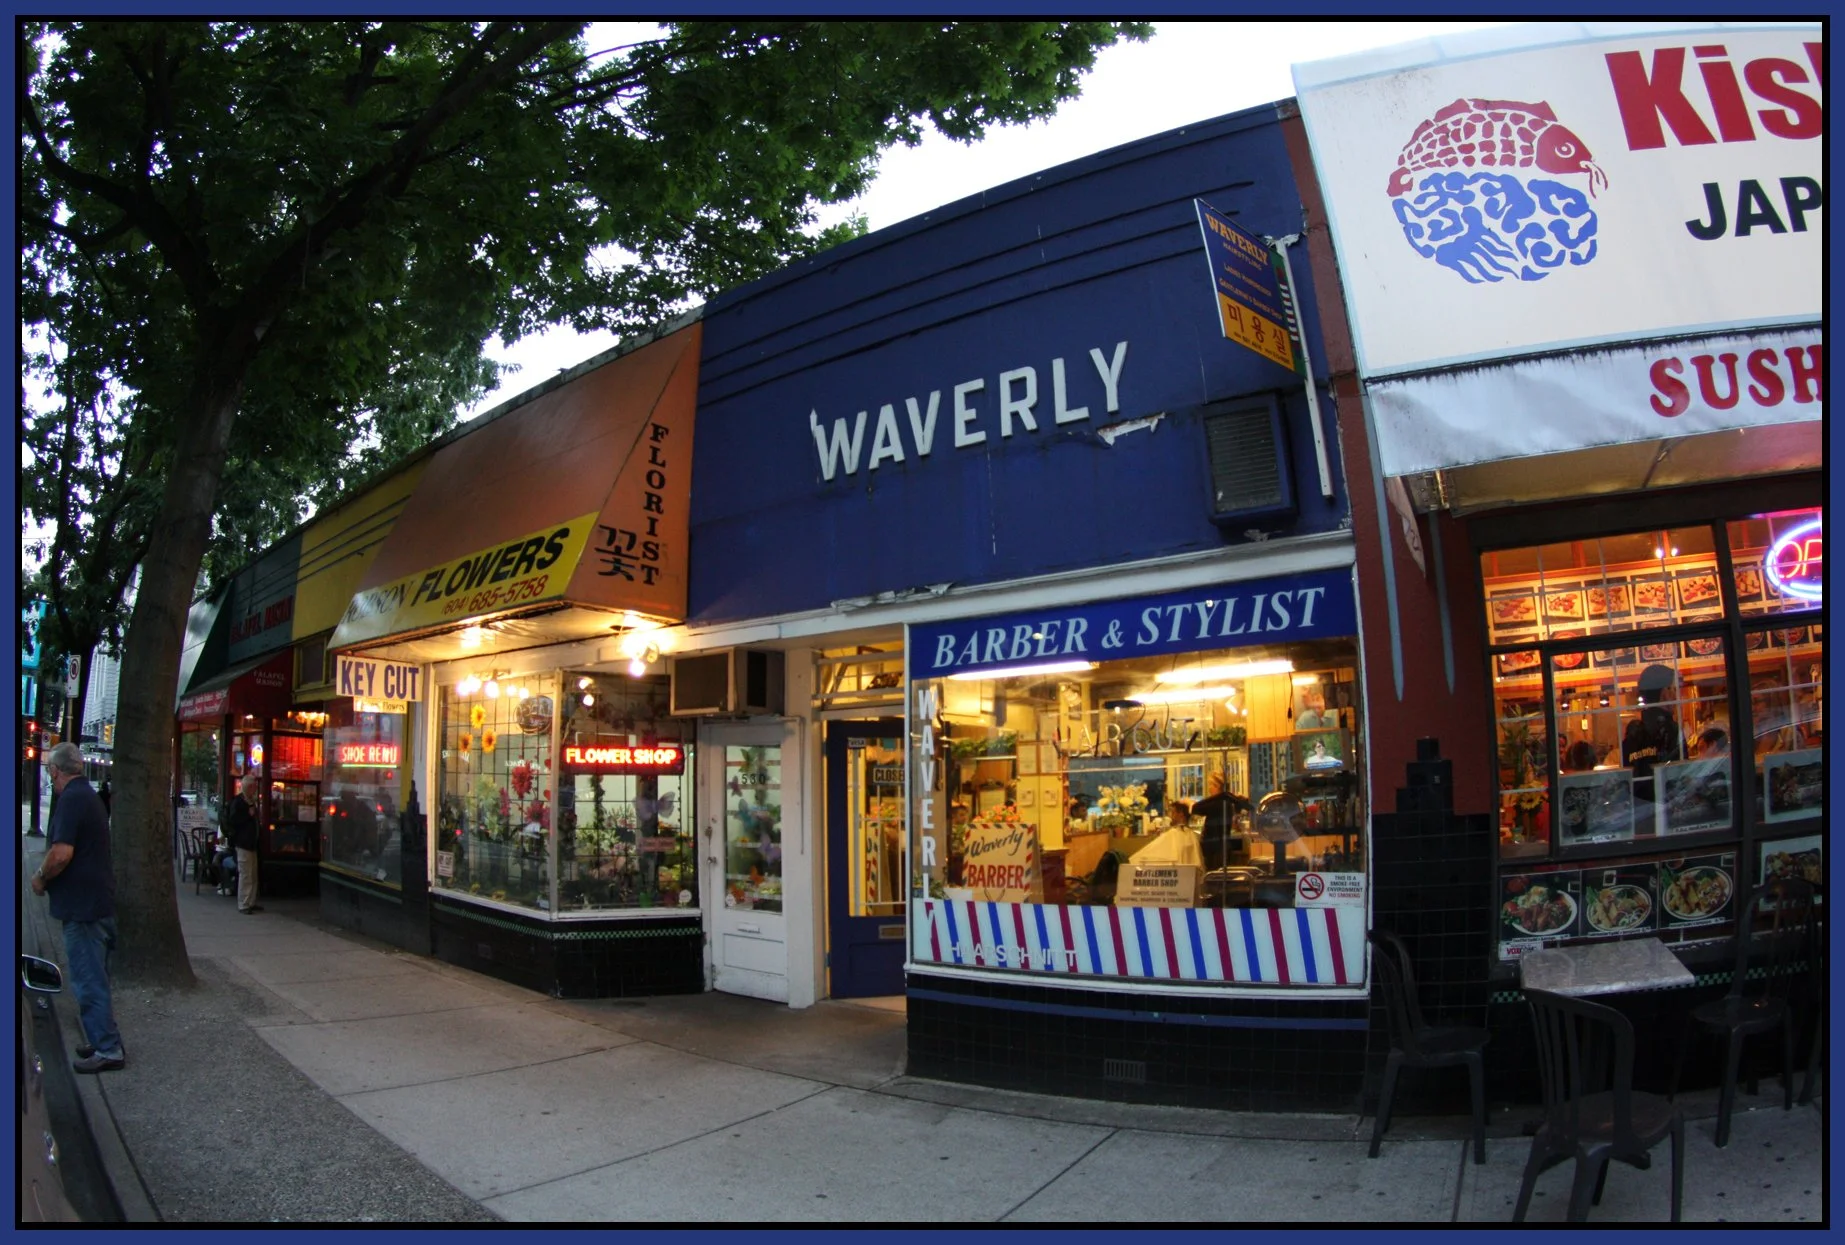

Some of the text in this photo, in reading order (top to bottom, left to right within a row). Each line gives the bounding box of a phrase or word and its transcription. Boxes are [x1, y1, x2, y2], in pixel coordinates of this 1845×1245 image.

[1605, 42, 1822, 151] Kis
[1204, 212, 1269, 266] WAVERLY
[810, 341, 1128, 482] WAVERLY
[640, 422, 670, 586] FLORIST
[411, 527, 571, 607] FLOWERS
[468, 575, 549, 613] 685-5758
[931, 587, 1327, 668] BARBER & STYLIST
[341, 660, 420, 700] KEY CUT
[342, 745, 366, 763] SHOE
[565, 747, 677, 764] FLOWER SHOP
[742, 773, 766, 785] 530
[970, 829, 1024, 858] Waverly
[967, 864, 1024, 889] BARBER
[1133, 878, 1179, 887] BARBER SHOP
